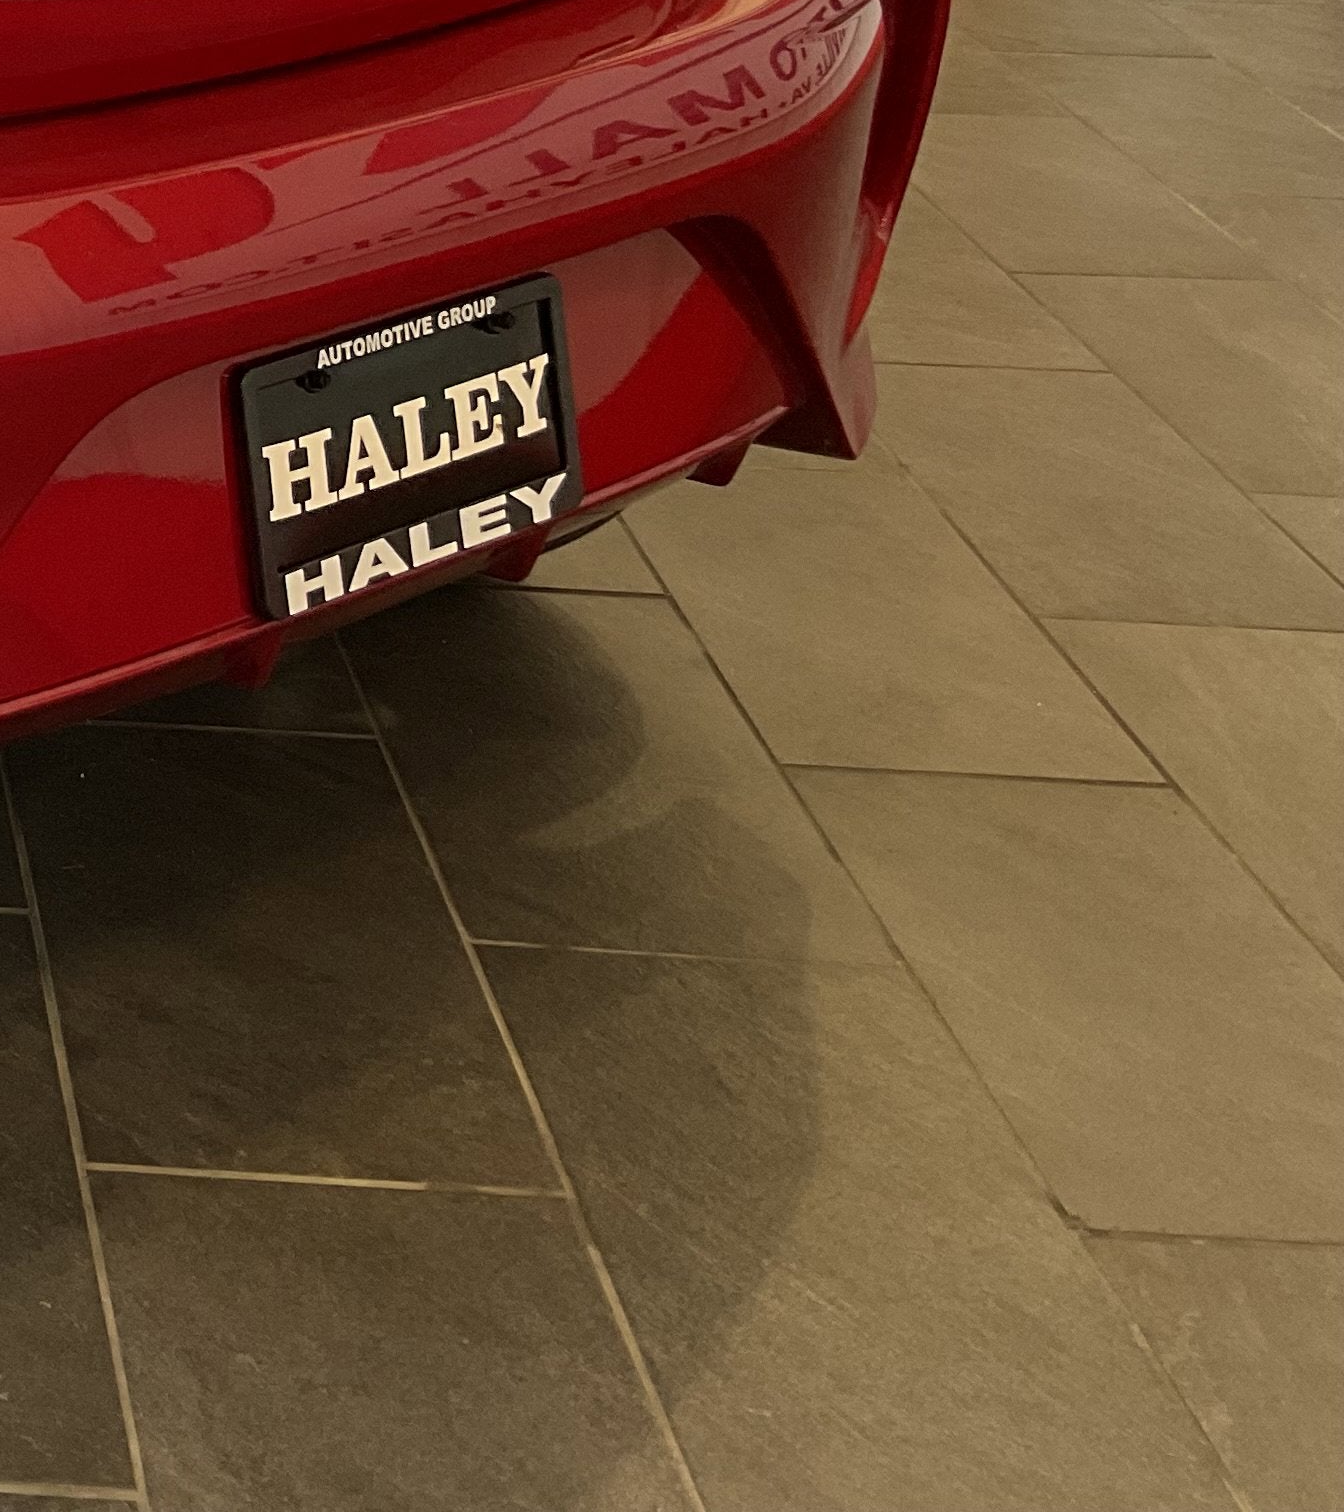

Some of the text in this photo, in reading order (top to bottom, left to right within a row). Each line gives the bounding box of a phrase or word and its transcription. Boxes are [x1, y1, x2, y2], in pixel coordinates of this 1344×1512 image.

[316, 295, 498, 369] AUTOMOTIVE GROUP
[261, 352, 551, 524] HALEY
[284, 472, 567, 617] HALEY
